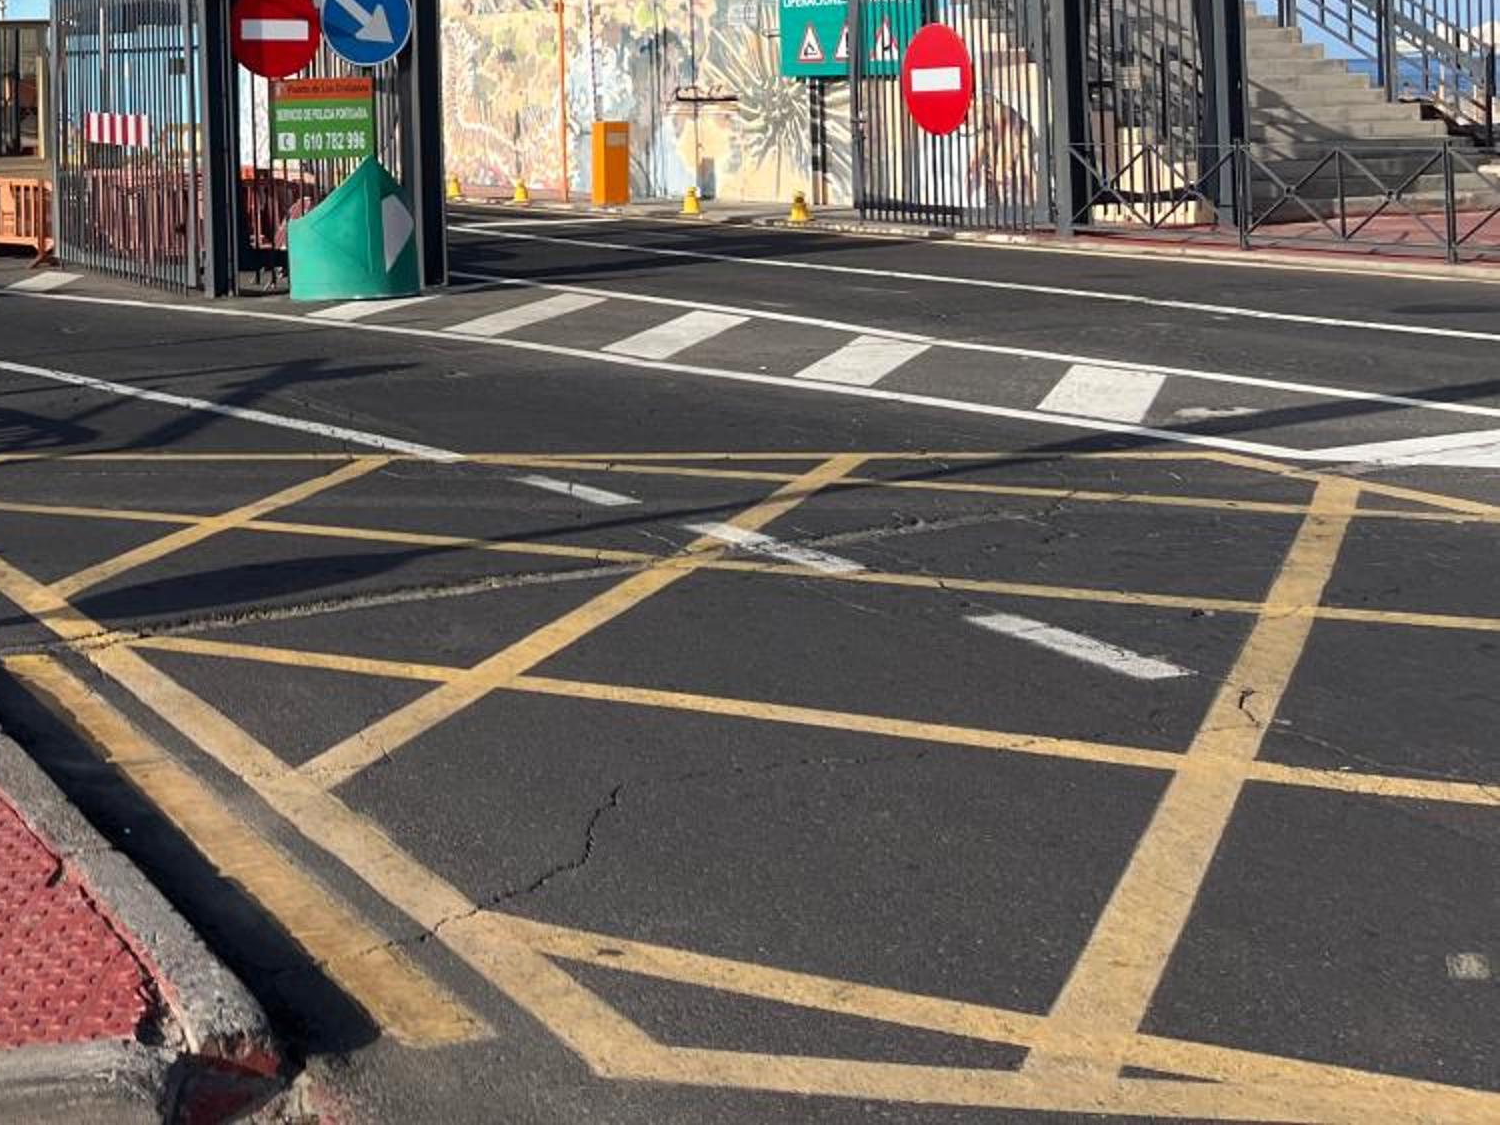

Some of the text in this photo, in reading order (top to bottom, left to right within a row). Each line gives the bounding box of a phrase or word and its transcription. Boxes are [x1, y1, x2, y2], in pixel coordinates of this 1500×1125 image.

[303, 131, 365, 151] 610 782 996
